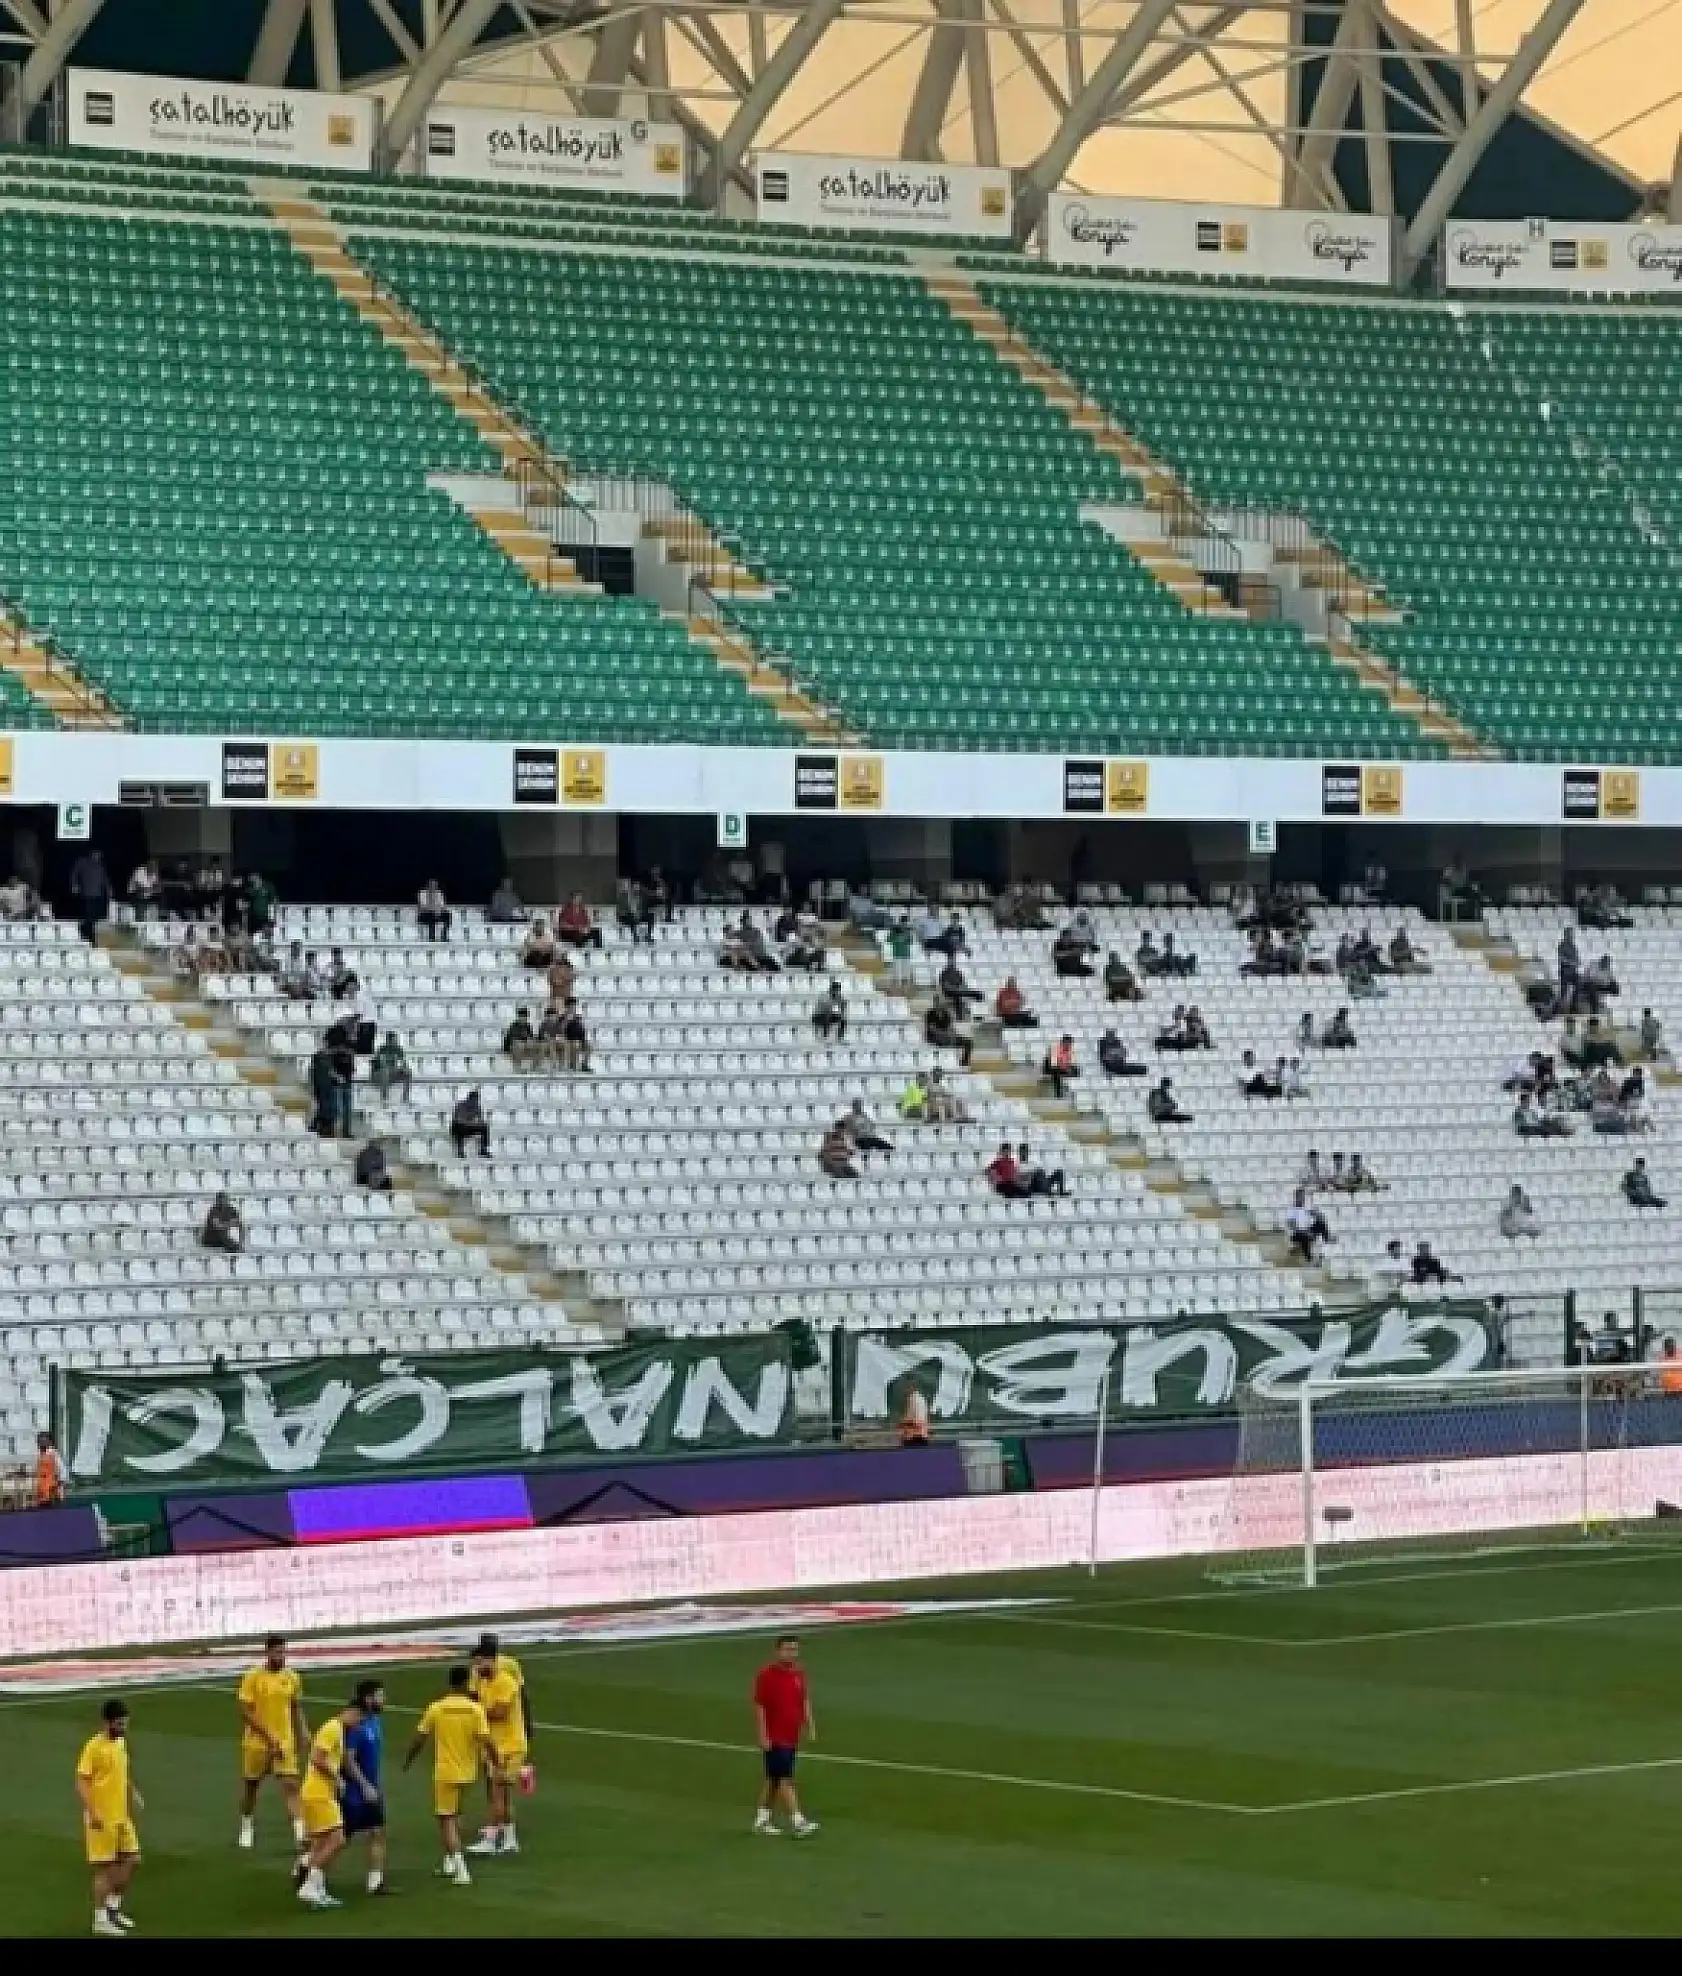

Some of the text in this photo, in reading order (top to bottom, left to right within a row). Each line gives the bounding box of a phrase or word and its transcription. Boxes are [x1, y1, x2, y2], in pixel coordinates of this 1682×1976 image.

[630, 120, 648, 139] G
[1529, 220, 1544, 237] H
[66, 805, 84, 827] C
[725, 815, 740, 835] D
[1256, 821, 1270, 841] E
[852, 1306, 1489, 1418] GRUBU
[71, 1354, 789, 1476] NALÇACI
